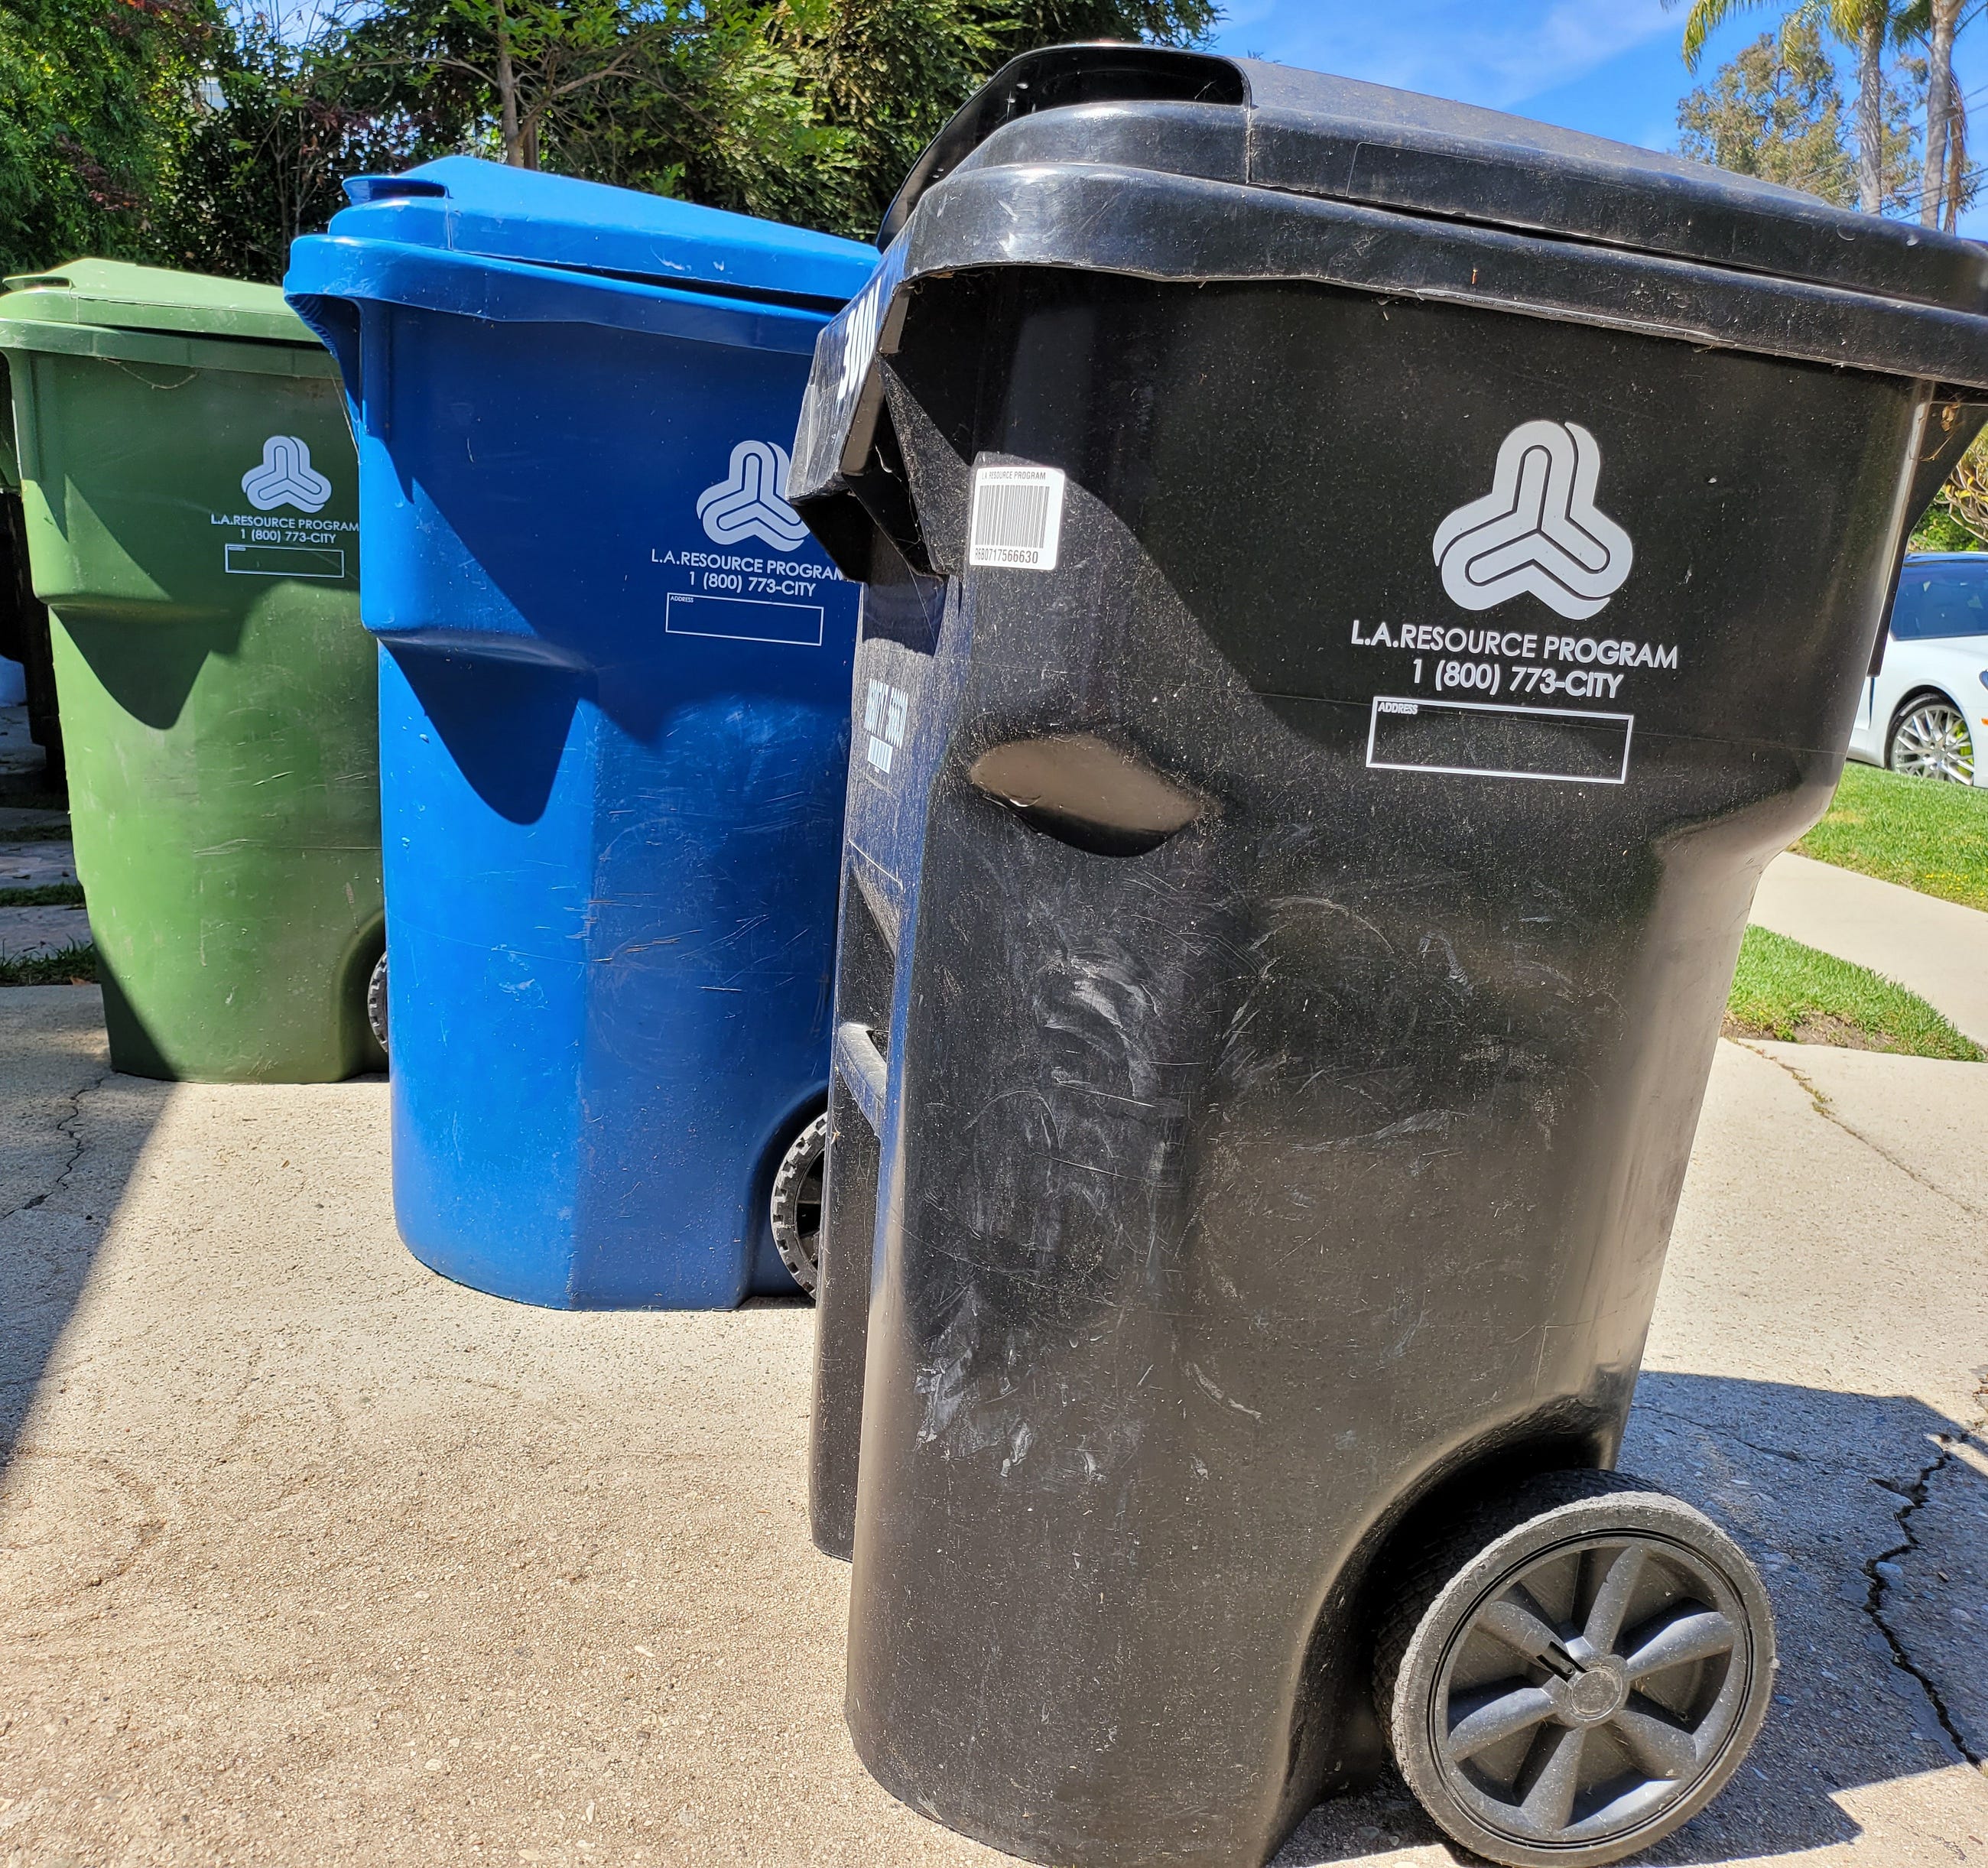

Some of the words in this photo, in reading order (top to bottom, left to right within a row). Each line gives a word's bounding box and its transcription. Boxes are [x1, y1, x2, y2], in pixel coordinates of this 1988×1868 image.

[1014, 471, 1046, 480] PROGRAM
[299, 519, 359, 531] PROGRAM
[241, 528, 245, 539] 1
[252, 529, 281, 543] (800)
[285, 532, 336, 544] 773-CITY
[690, 571, 695, 586] 1
[703, 572, 742, 593] (800)
[748, 577, 817, 597] 773-CITY
[1543, 635, 1678, 670] PROGRAM
[1414, 658, 1423, 684] 1
[1435, 660, 1501, 696] (800)
[1509, 666, 1625, 699] 773-CITY
[1377, 701, 1418, 715] ADDRESS
